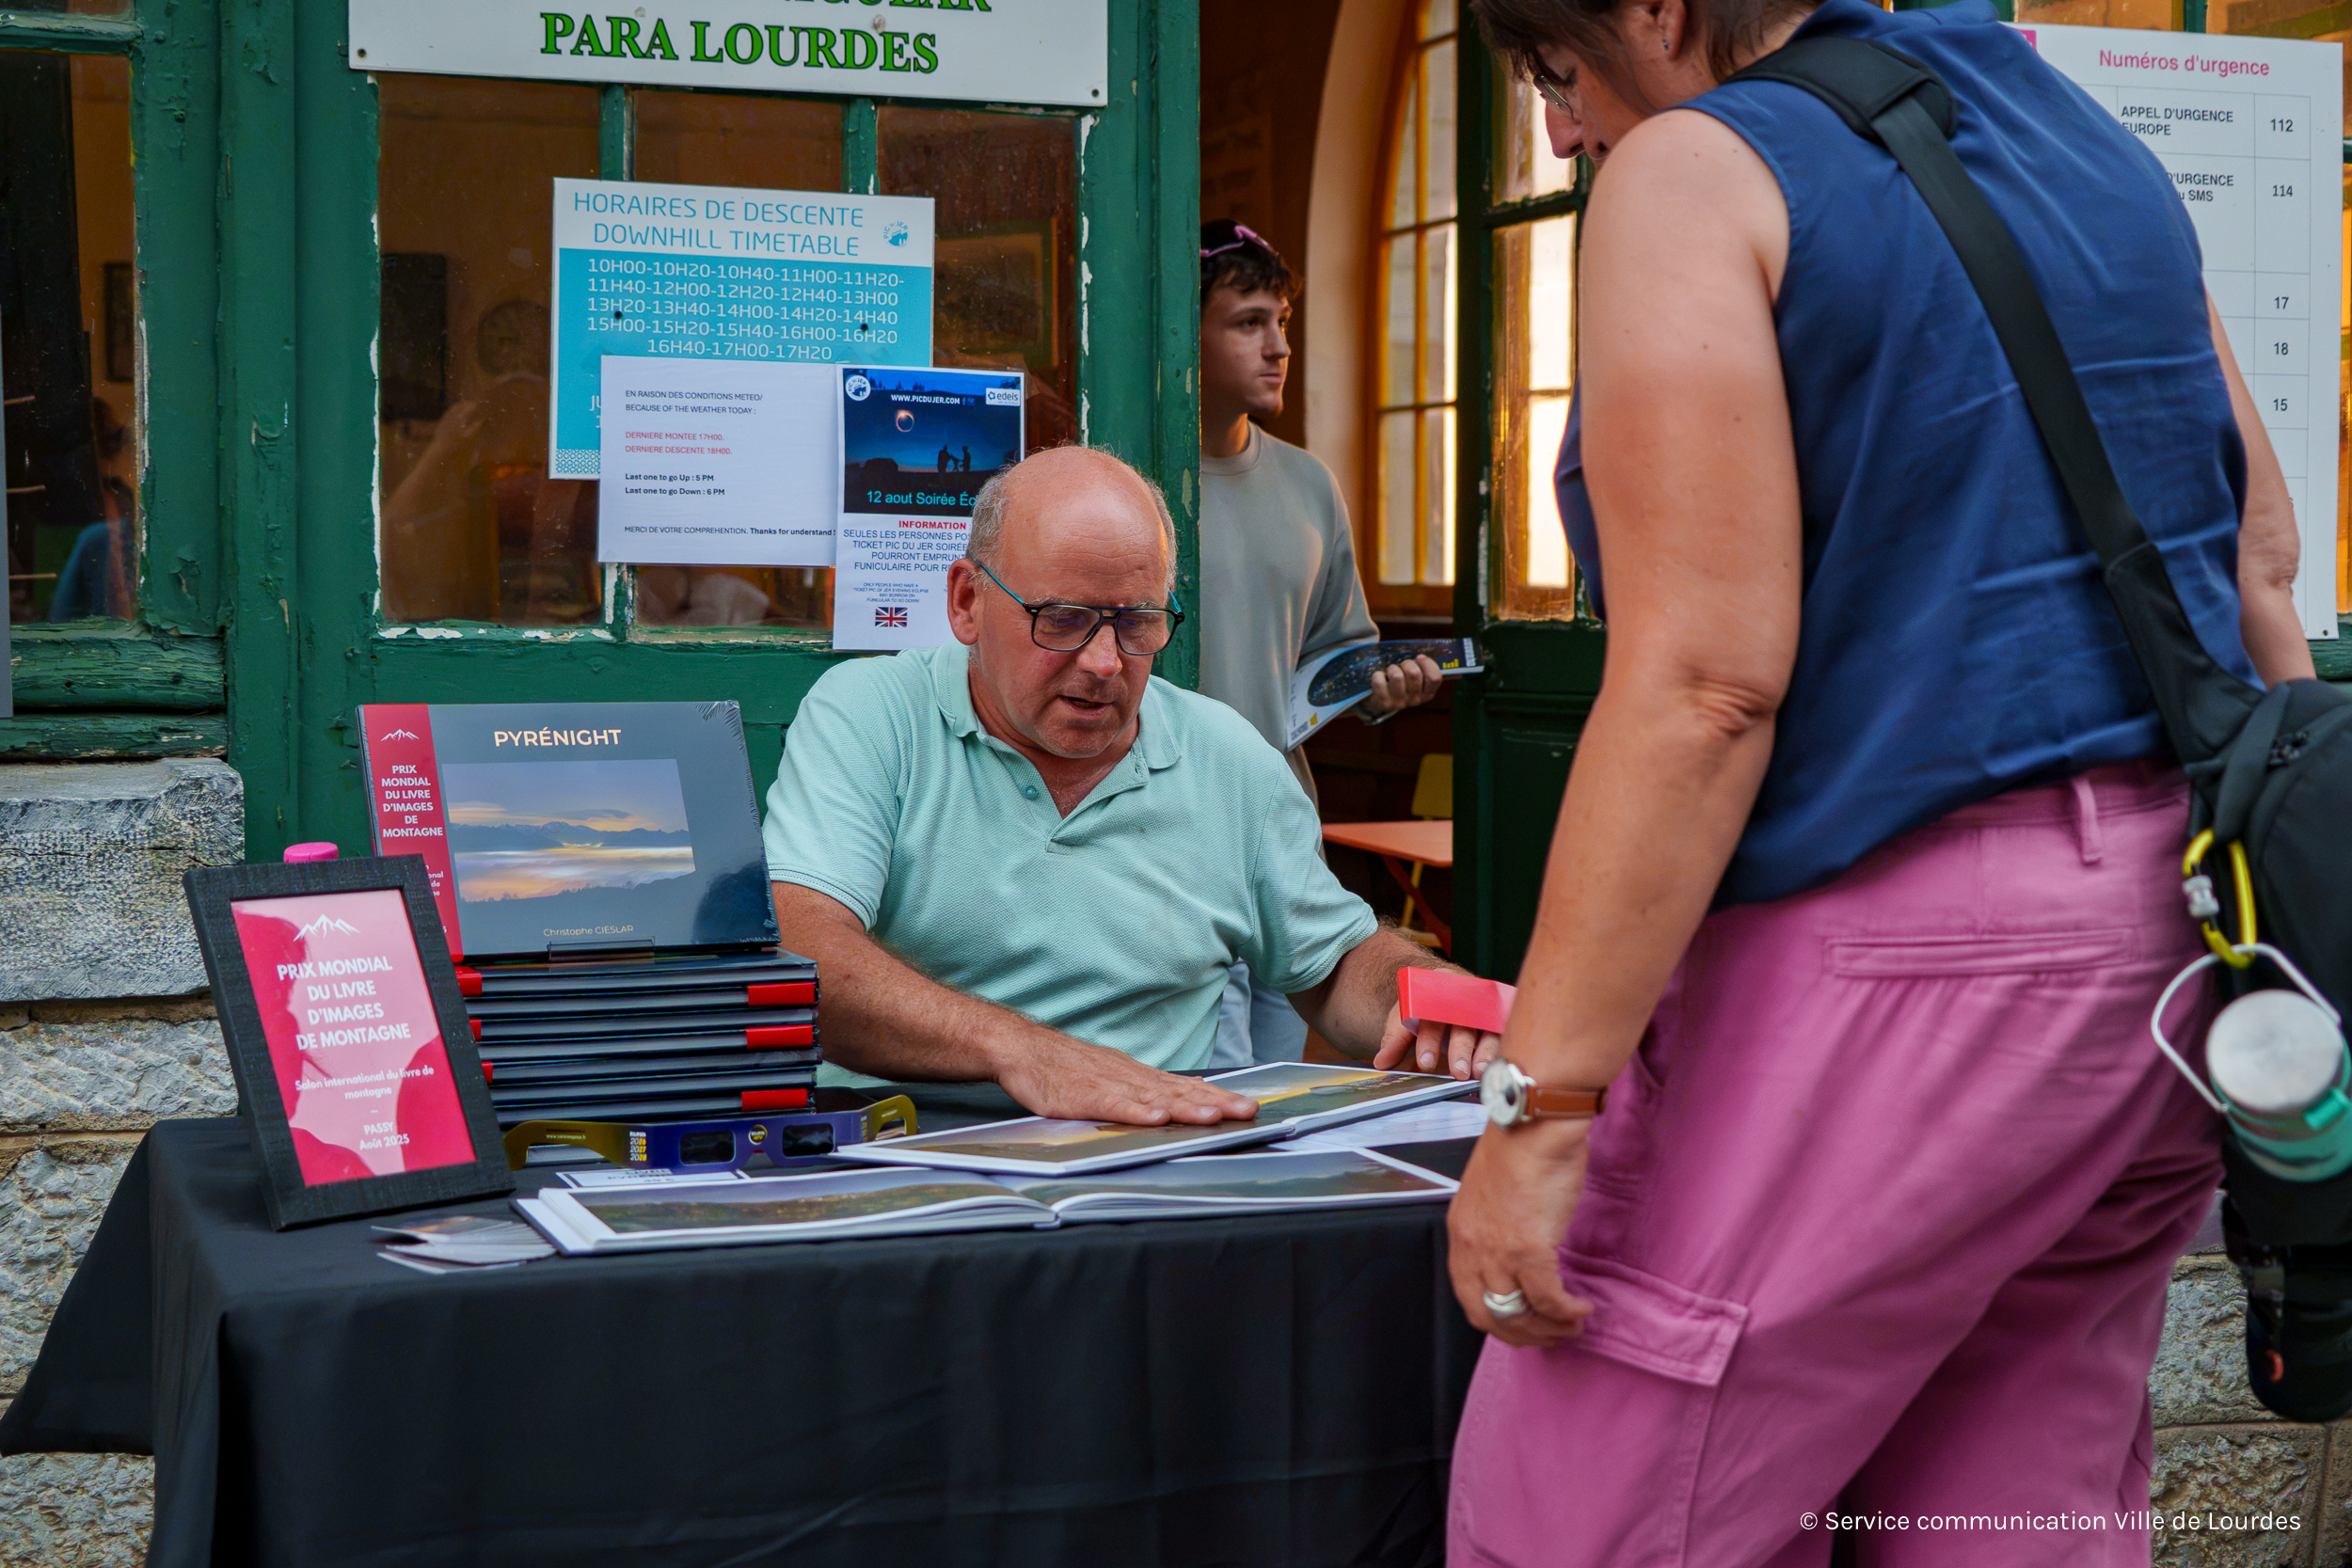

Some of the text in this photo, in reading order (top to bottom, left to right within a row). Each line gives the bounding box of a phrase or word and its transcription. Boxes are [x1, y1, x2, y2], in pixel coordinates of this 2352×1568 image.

[540, 12, 939, 74] PARA LOURDES
[2099, 50, 2270, 77] Numéros d'urgence
[2121, 105, 2233, 122] APPEL D'URGENCE
[2122, 122, 2171, 135] EUROPE
[2270, 119, 2294, 133] 112
[2188, 190, 2214, 202] SMS
[2272, 184, 2294, 198] 114
[574, 192, 864, 228] HORAIRES DE DESCENTE
[595, 223, 860, 257] DOWNHILL TIMETABLE
[587, 278, 898, 306] 11H40-12H00-12H20-12H40-13H00
[2273, 296, 2290, 309] 17
[587, 297, 898, 325] 13H20-13H40-14H00-14H20-14H40
[587, 317, 898, 344] 15H00-15H20-15H40-16H00-16H20
[647, 340, 832, 360] 16H40-17H00-17H20
[2273, 342, 2289, 356] 18
[638, 390, 667, 399] RAISON
[685, 391, 734, 400] CONDITIONS
[890, 394, 961, 404] WWW.PICDUJER.COM
[996, 391, 1019, 401] edeis
[675, 404, 690, 413] THE
[691, 405, 726, 414] WEATHER
[2273, 399, 2288, 412] 15
[698, 433, 724, 441] 17H00.
[664, 446, 706, 454] DESCENTE
[679, 474, 691, 483] Up
[679, 487, 702, 496] Down
[866, 491, 882, 503] 12
[884, 493, 913, 504] aout
[916, 492, 956, 506] Soirée
[683, 527, 749, 535] COMPREHENTION.
[750, 528, 777, 536] Thanks
[778, 528, 789, 536] for
[898, 520, 967, 531] INFORMATION
[843, 529, 879, 539] SEULES
[880, 531, 897, 540] LES
[898, 531, 953, 541] PERSONNES
[852, 540, 967, 551] TICKET PIC DU JER SOIRÉE
[871, 551, 922, 561] POURRONT
[854, 562, 913, 571] FUNICULAIRE
[914, 562, 941, 572] POUR
[494, 726, 622, 748] PYRÉNIGHT
[391, 765, 418, 774] PRIX
[381, 777, 431, 787] MONDIAL
[385, 789, 431, 800] DU LIVRE
[382, 801, 434, 813] D'IMAGES
[405, 816, 419, 825] DE
[382, 827, 443, 838] MONTAGNE
[543, 925, 634, 938] Christophe CIESLAR
[277, 956, 393, 980] PRIX MONDIAL
[307, 980, 376, 1002] DU LIVRE
[307, 1003, 384, 1025] D'IMAGES
[296, 1023, 411, 1051] DE MONTAGNE
[294, 1065, 435, 1091] Salon international du livre de
[344, 1086, 392, 1102] montagne
[363, 1121, 393, 1135] PASSY
[359, 1133, 410, 1150] Août 2025
